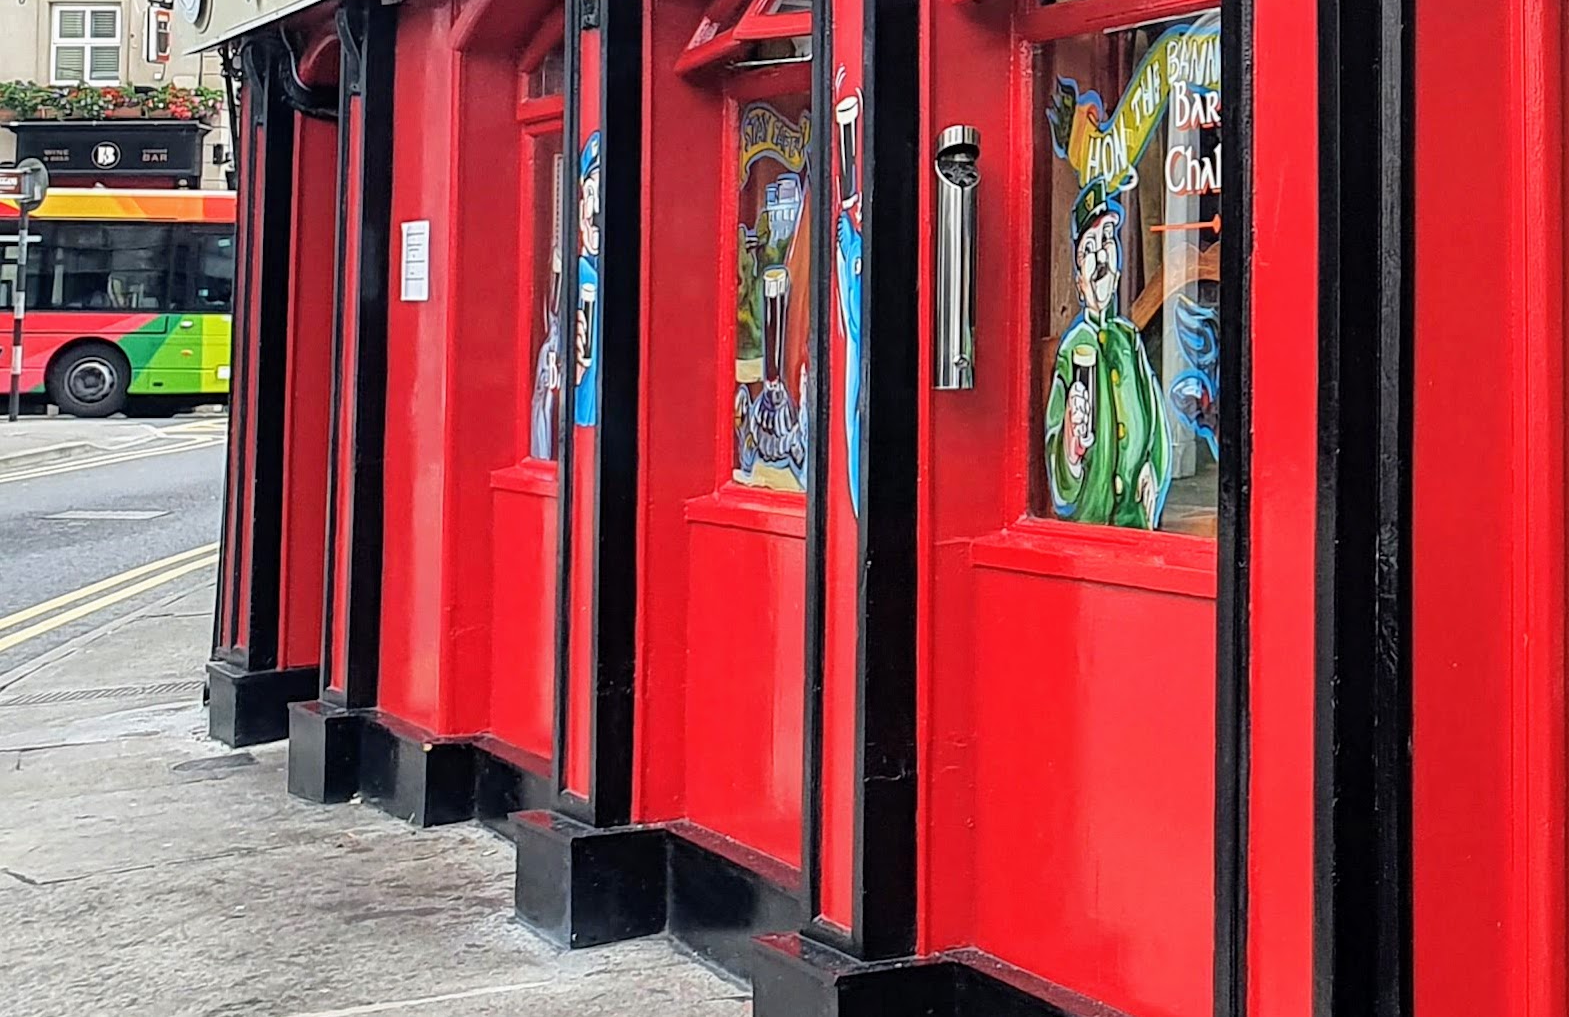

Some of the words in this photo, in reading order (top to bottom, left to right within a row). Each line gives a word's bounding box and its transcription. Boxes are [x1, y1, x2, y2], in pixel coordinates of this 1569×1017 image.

[1087, 113, 1129, 184] HON
[1131, 62, 1161, 125] THE
[1166, 36, 1221, 86] BANN
[1174, 81, 1221, 128] Bar
[1165, 143, 1221, 193] Chal
